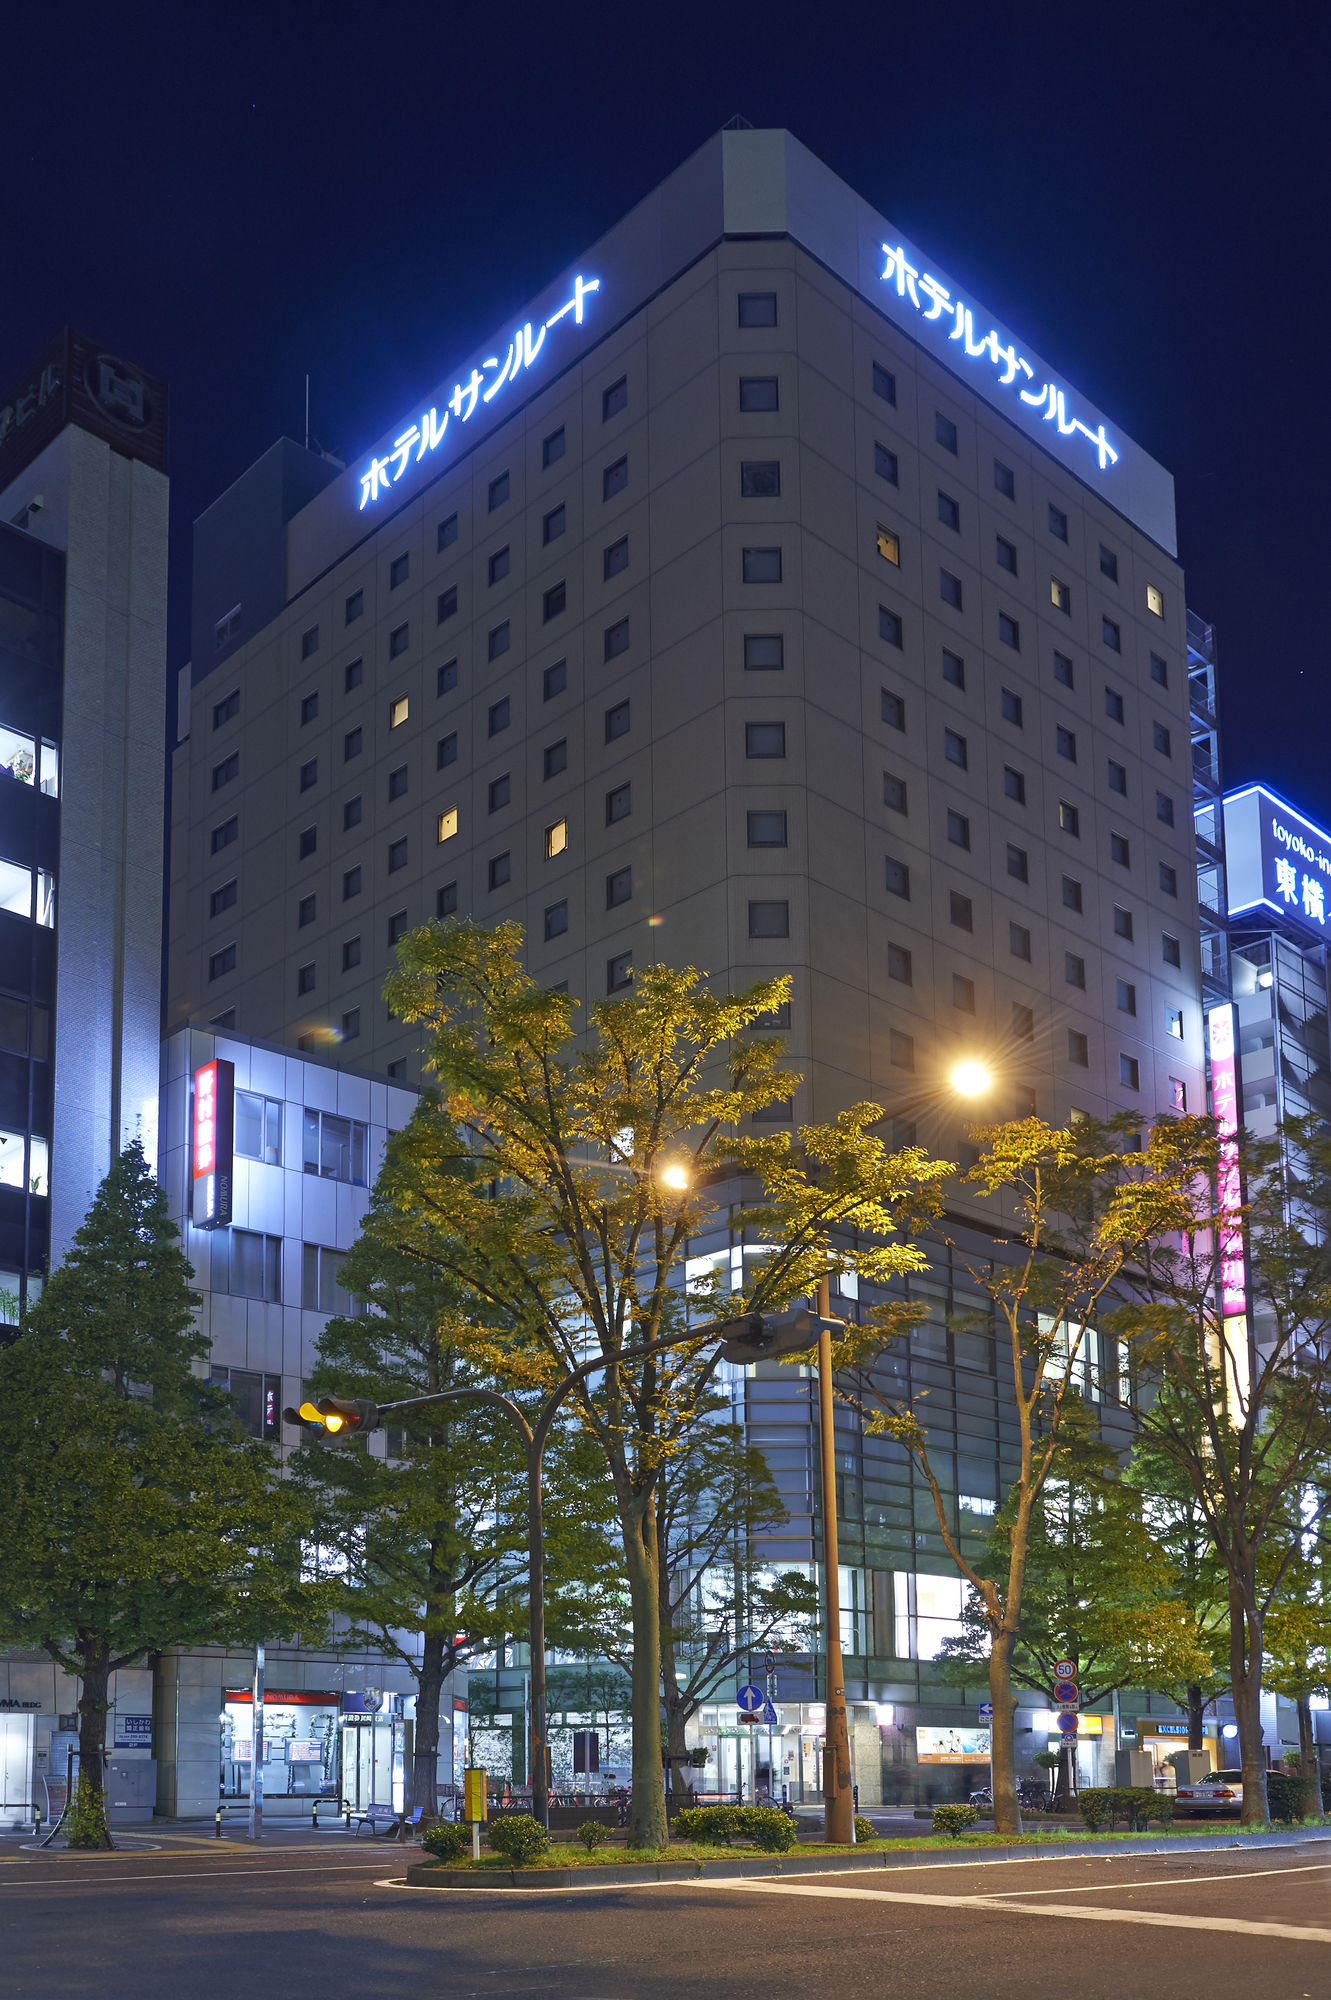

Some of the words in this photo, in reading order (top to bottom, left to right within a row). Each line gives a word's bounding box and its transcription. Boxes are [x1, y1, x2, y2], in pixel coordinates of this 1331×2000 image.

[880, 243, 1119, 470] ホテルサンルート
[358, 275, 601, 512] ホテルサンルート
[1272, 818, 1331, 876] toyoko-in
[219, 1175, 228, 1217] NOMURA
[1057, 1664, 1073, 1676] 50
